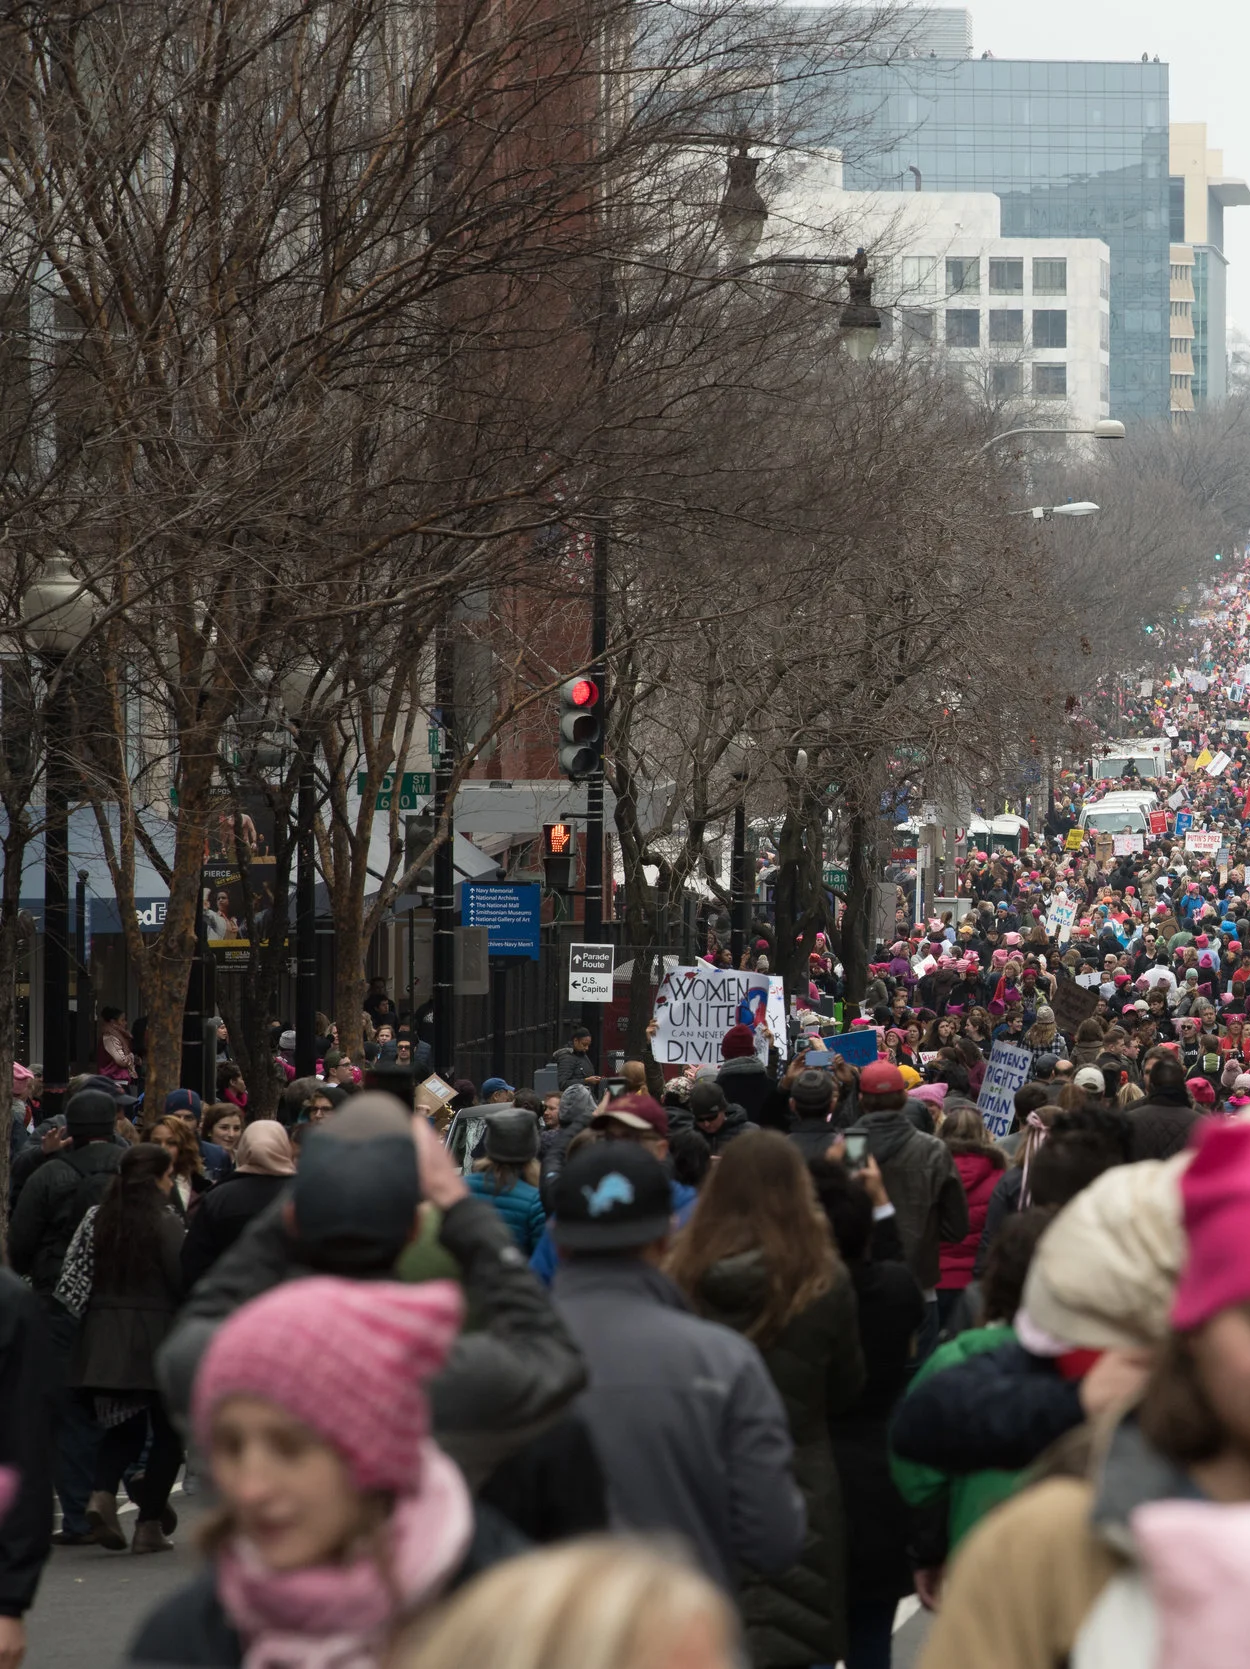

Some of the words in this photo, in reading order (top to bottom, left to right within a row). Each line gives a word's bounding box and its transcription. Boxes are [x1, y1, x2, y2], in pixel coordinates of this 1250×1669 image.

[412, 774, 427, 784] ST
[412, 784, 427, 793] NW
[380, 796, 410, 808] 60
[1056, 906, 1073, 919] MY
[582, 952, 610, 961] Parade
[582, 961, 605, 969] Route
[581, 976, 598, 984] U.S.
[581, 985, 609, 994] Capitol
[668, 977, 750, 1003] WOMEN
[671, 1030, 694, 1038] CAN
[697, 1029, 726, 1040] NEVER
[990, 1048, 1029, 1071] WOMEN'S
[986, 1065, 1024, 1091] RIGHTS
[989, 1085, 1003, 1094] are
[977, 1092, 1011, 1115] HUMAN
